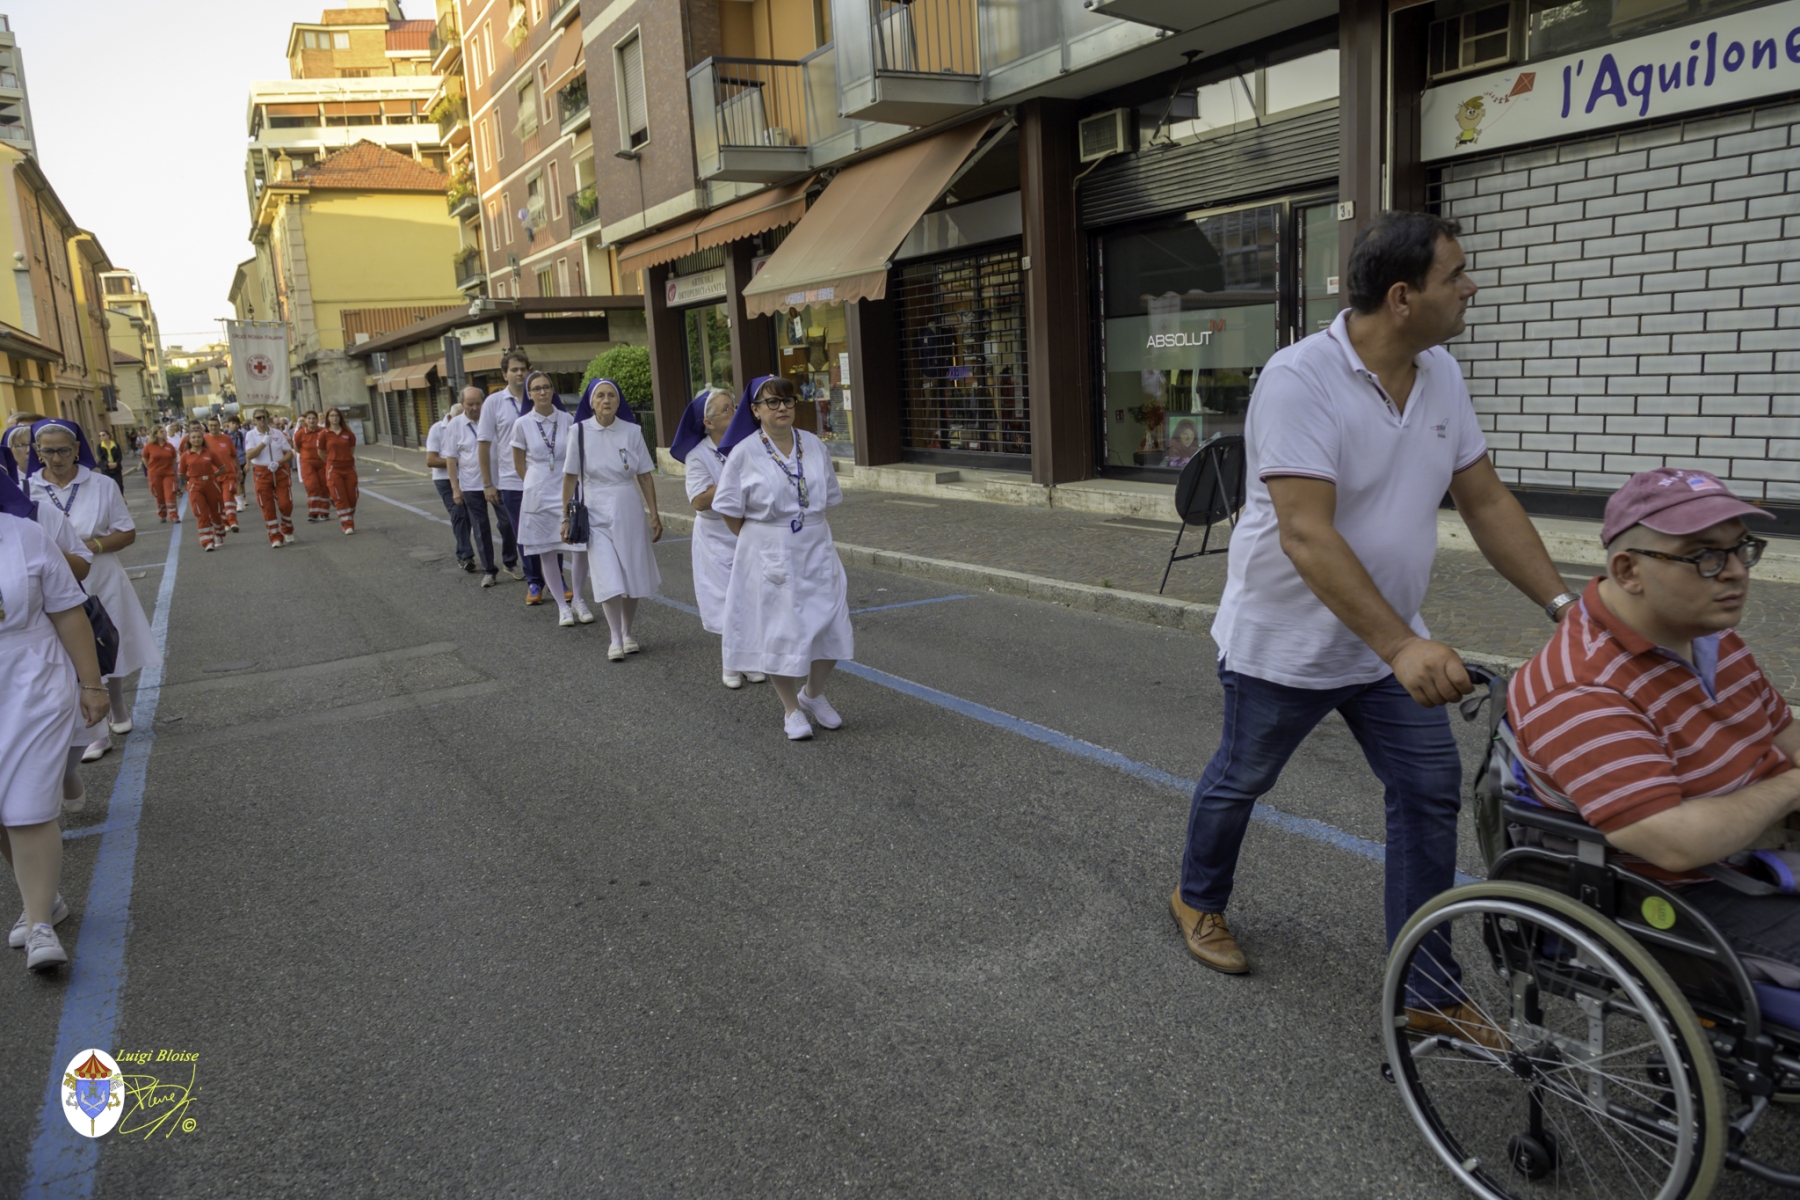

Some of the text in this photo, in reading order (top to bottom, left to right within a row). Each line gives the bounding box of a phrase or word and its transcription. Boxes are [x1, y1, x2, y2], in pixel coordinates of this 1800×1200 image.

[1561, 26, 1800, 118] l'Aquilone
[677, 286, 705, 300] ORTOPEDICI
[707, 282, 727, 294] SANITA
[691, 273, 714, 287] ARTICOLI
[1146, 317, 1225, 349] ABSOLUT M
